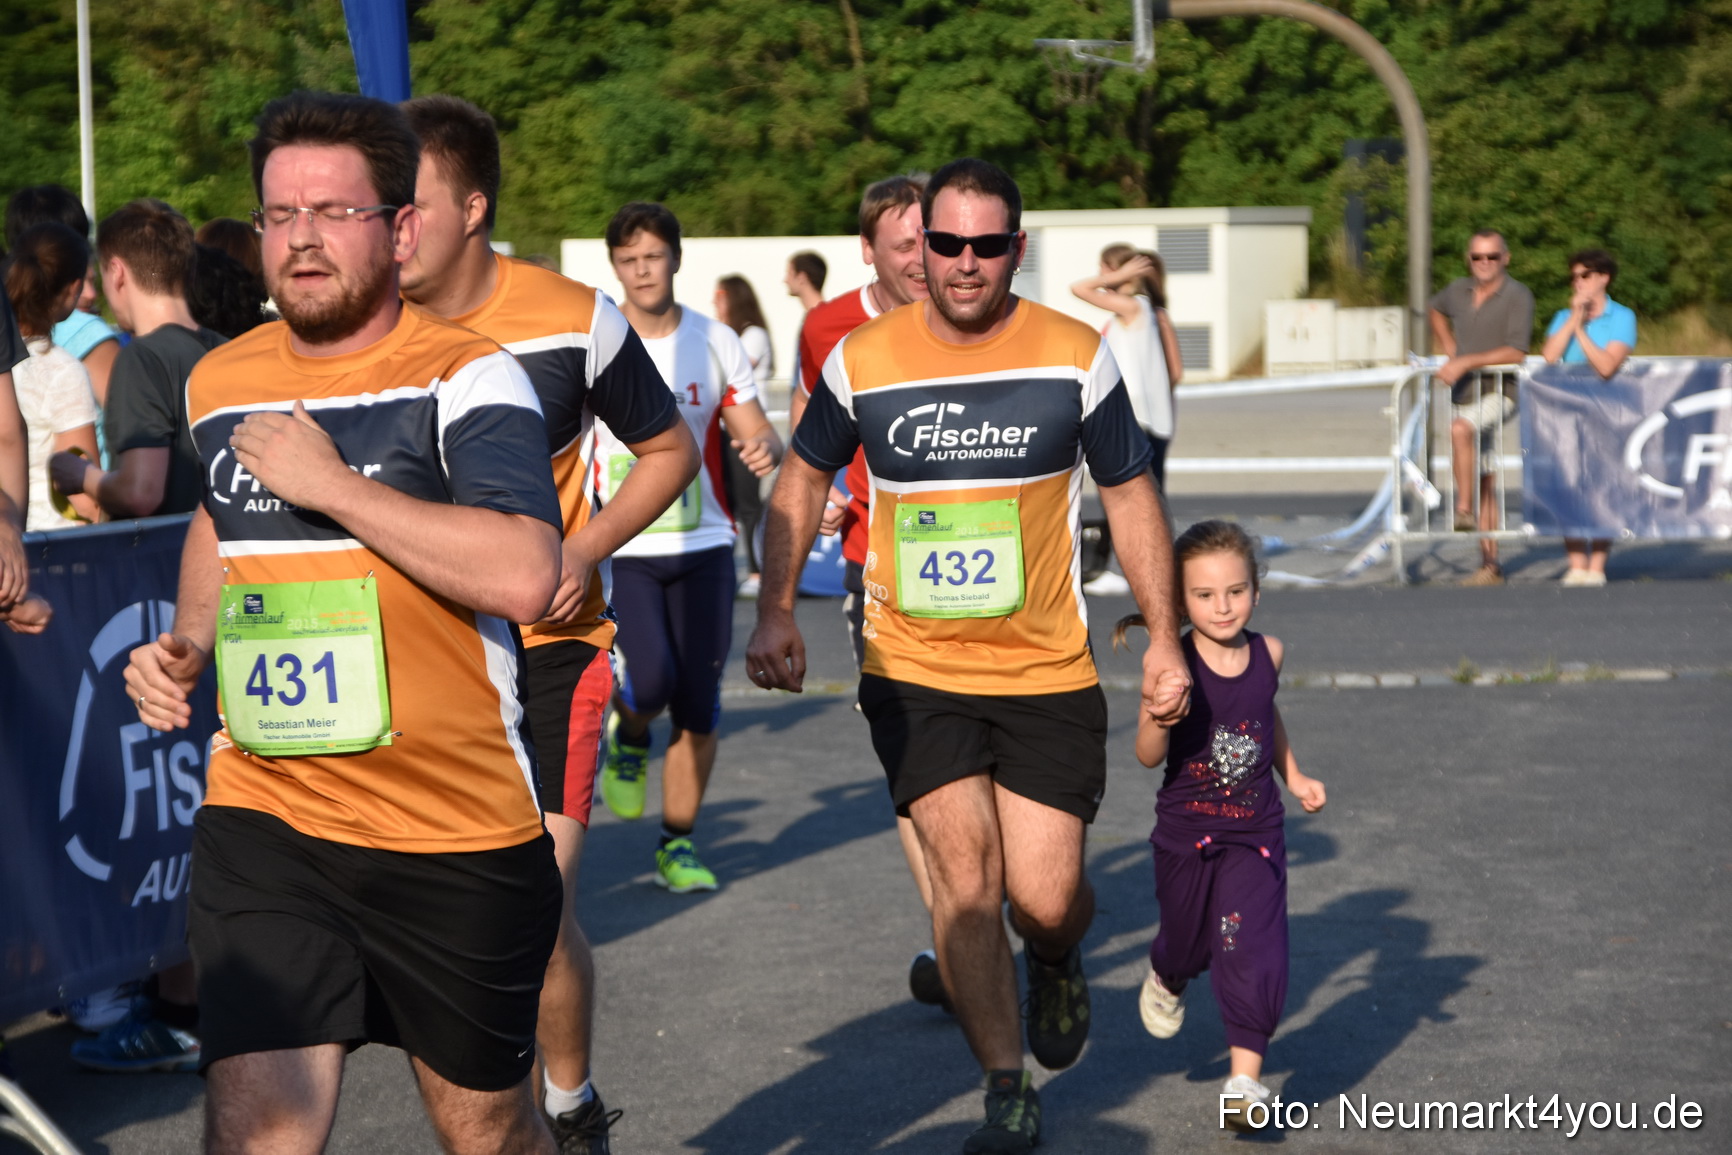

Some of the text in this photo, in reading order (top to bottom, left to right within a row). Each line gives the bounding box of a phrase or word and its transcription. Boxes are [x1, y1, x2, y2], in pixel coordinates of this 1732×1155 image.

[912, 421, 1038, 449] Fischer
[924, 447, 1028, 462] AUTOMOBILE
[919, 548, 997, 586] 432
[930, 592, 990, 602] Thomas Siebald
[235, 611, 285, 624] firmenlauf
[287, 617, 319, 630] 2015
[245, 650, 339, 707] 431
[257, 718, 337, 730] Sebastian Meier
